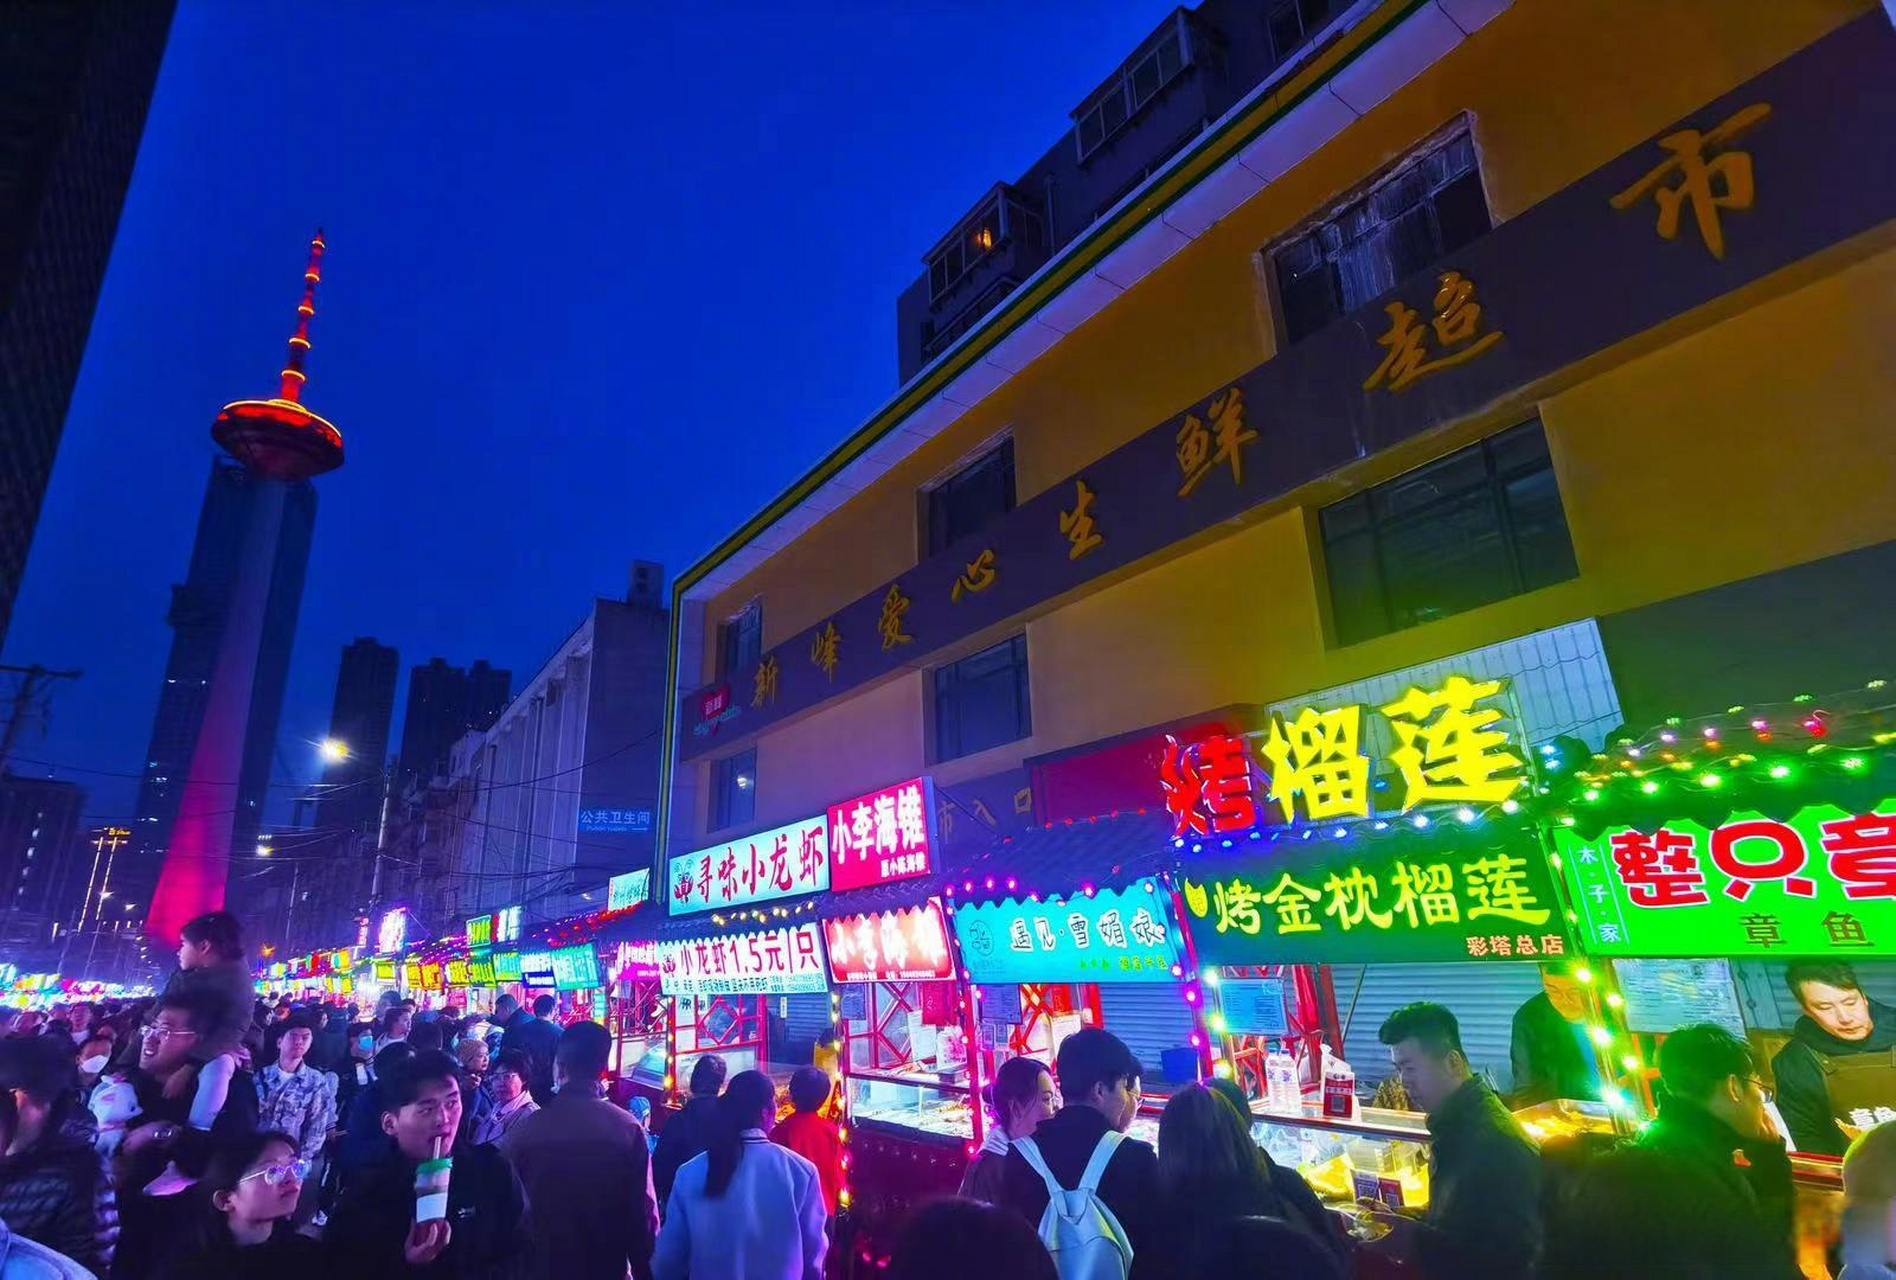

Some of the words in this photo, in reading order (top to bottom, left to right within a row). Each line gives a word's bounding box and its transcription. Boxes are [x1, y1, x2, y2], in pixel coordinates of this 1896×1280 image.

[750, 103, 1772, 708] 新峰爱心生鲜超市
[1160, 674, 1523, 838] 烤榴莲
[580, 810, 650, 824] 公共卫生间
[697, 826, 825, 903] 寻味小龙虾
[1214, 853, 1551, 935] 烤金枕榴莲
[1466, 934, 1564, 957] 彩塔总店
[1739, 910, 1875, 948] 章鱼
